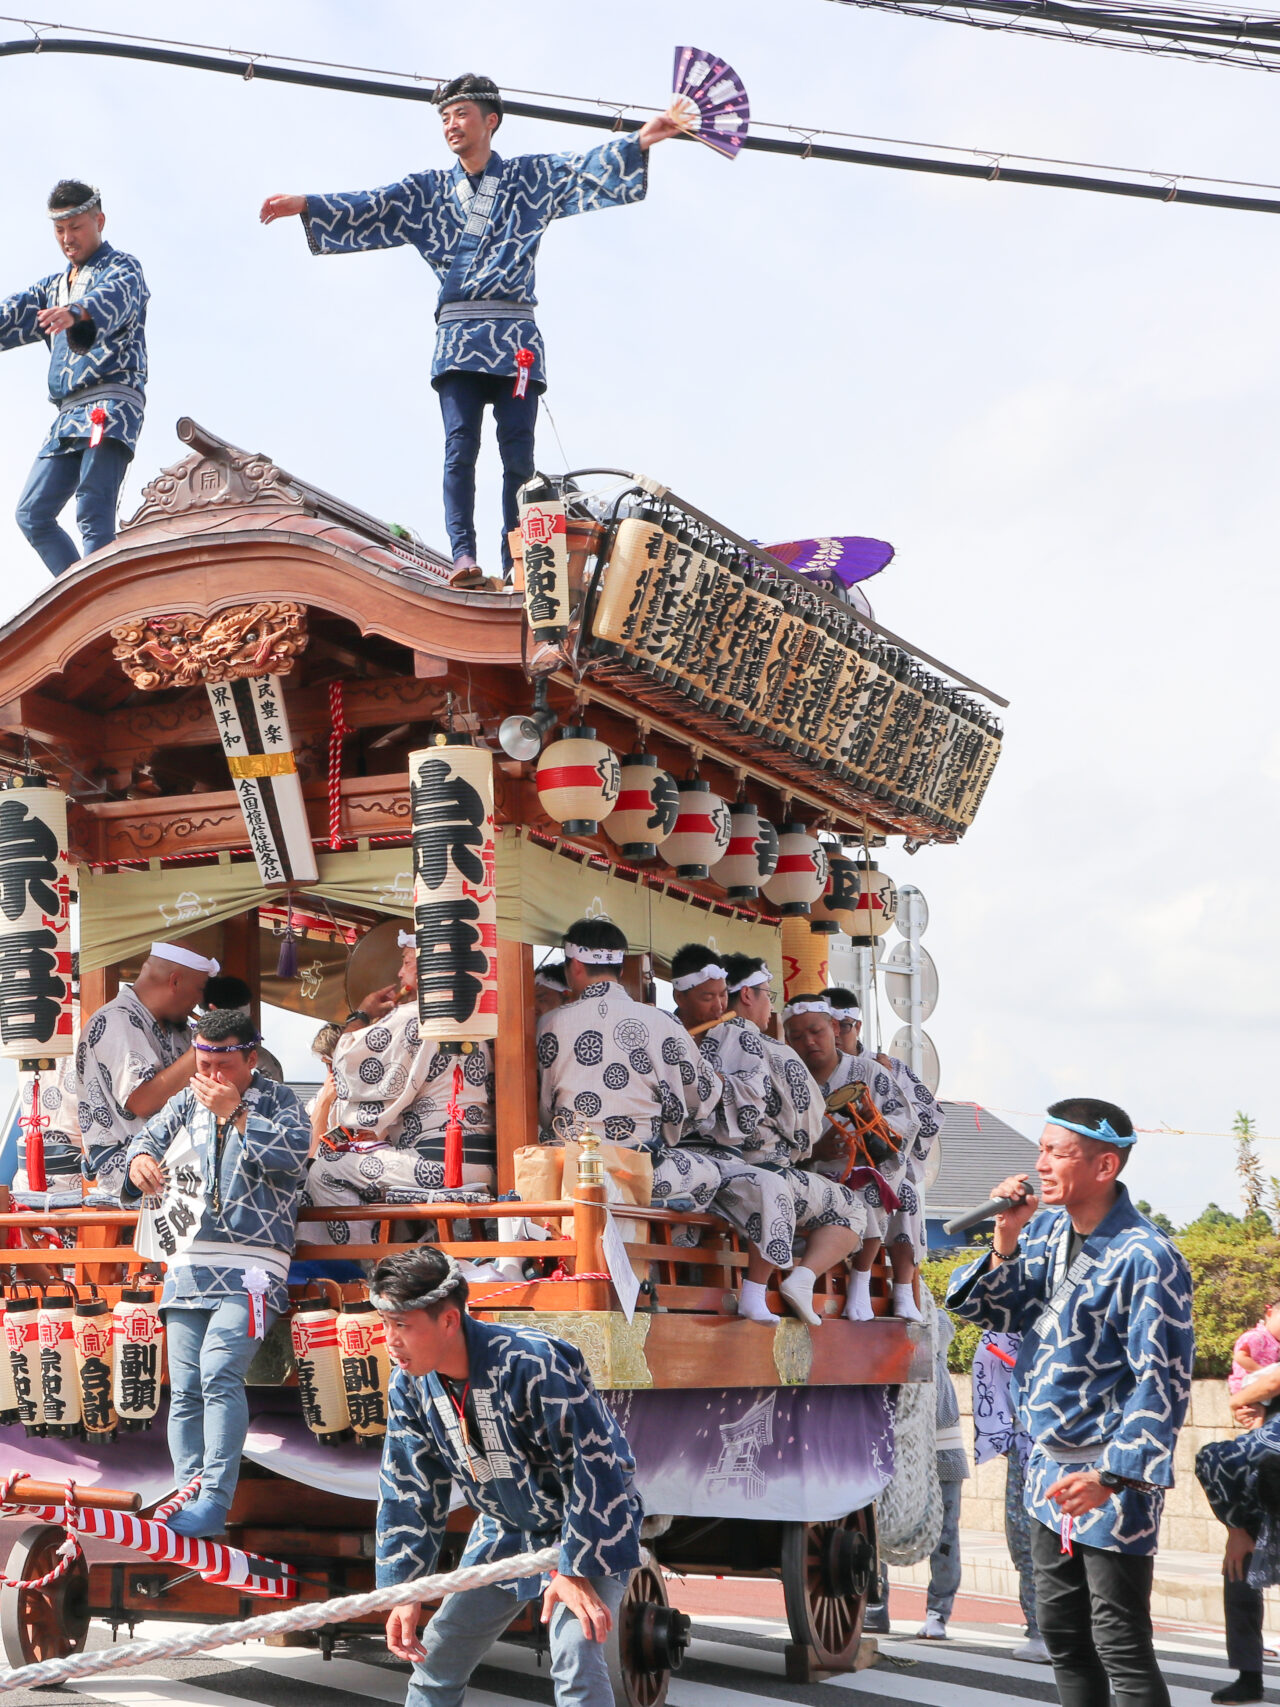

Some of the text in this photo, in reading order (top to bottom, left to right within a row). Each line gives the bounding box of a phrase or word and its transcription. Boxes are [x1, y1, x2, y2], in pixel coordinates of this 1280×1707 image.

[239, 779, 282, 881] 全国檀信徒各位
[120, 1343, 157, 1412] 副頭
